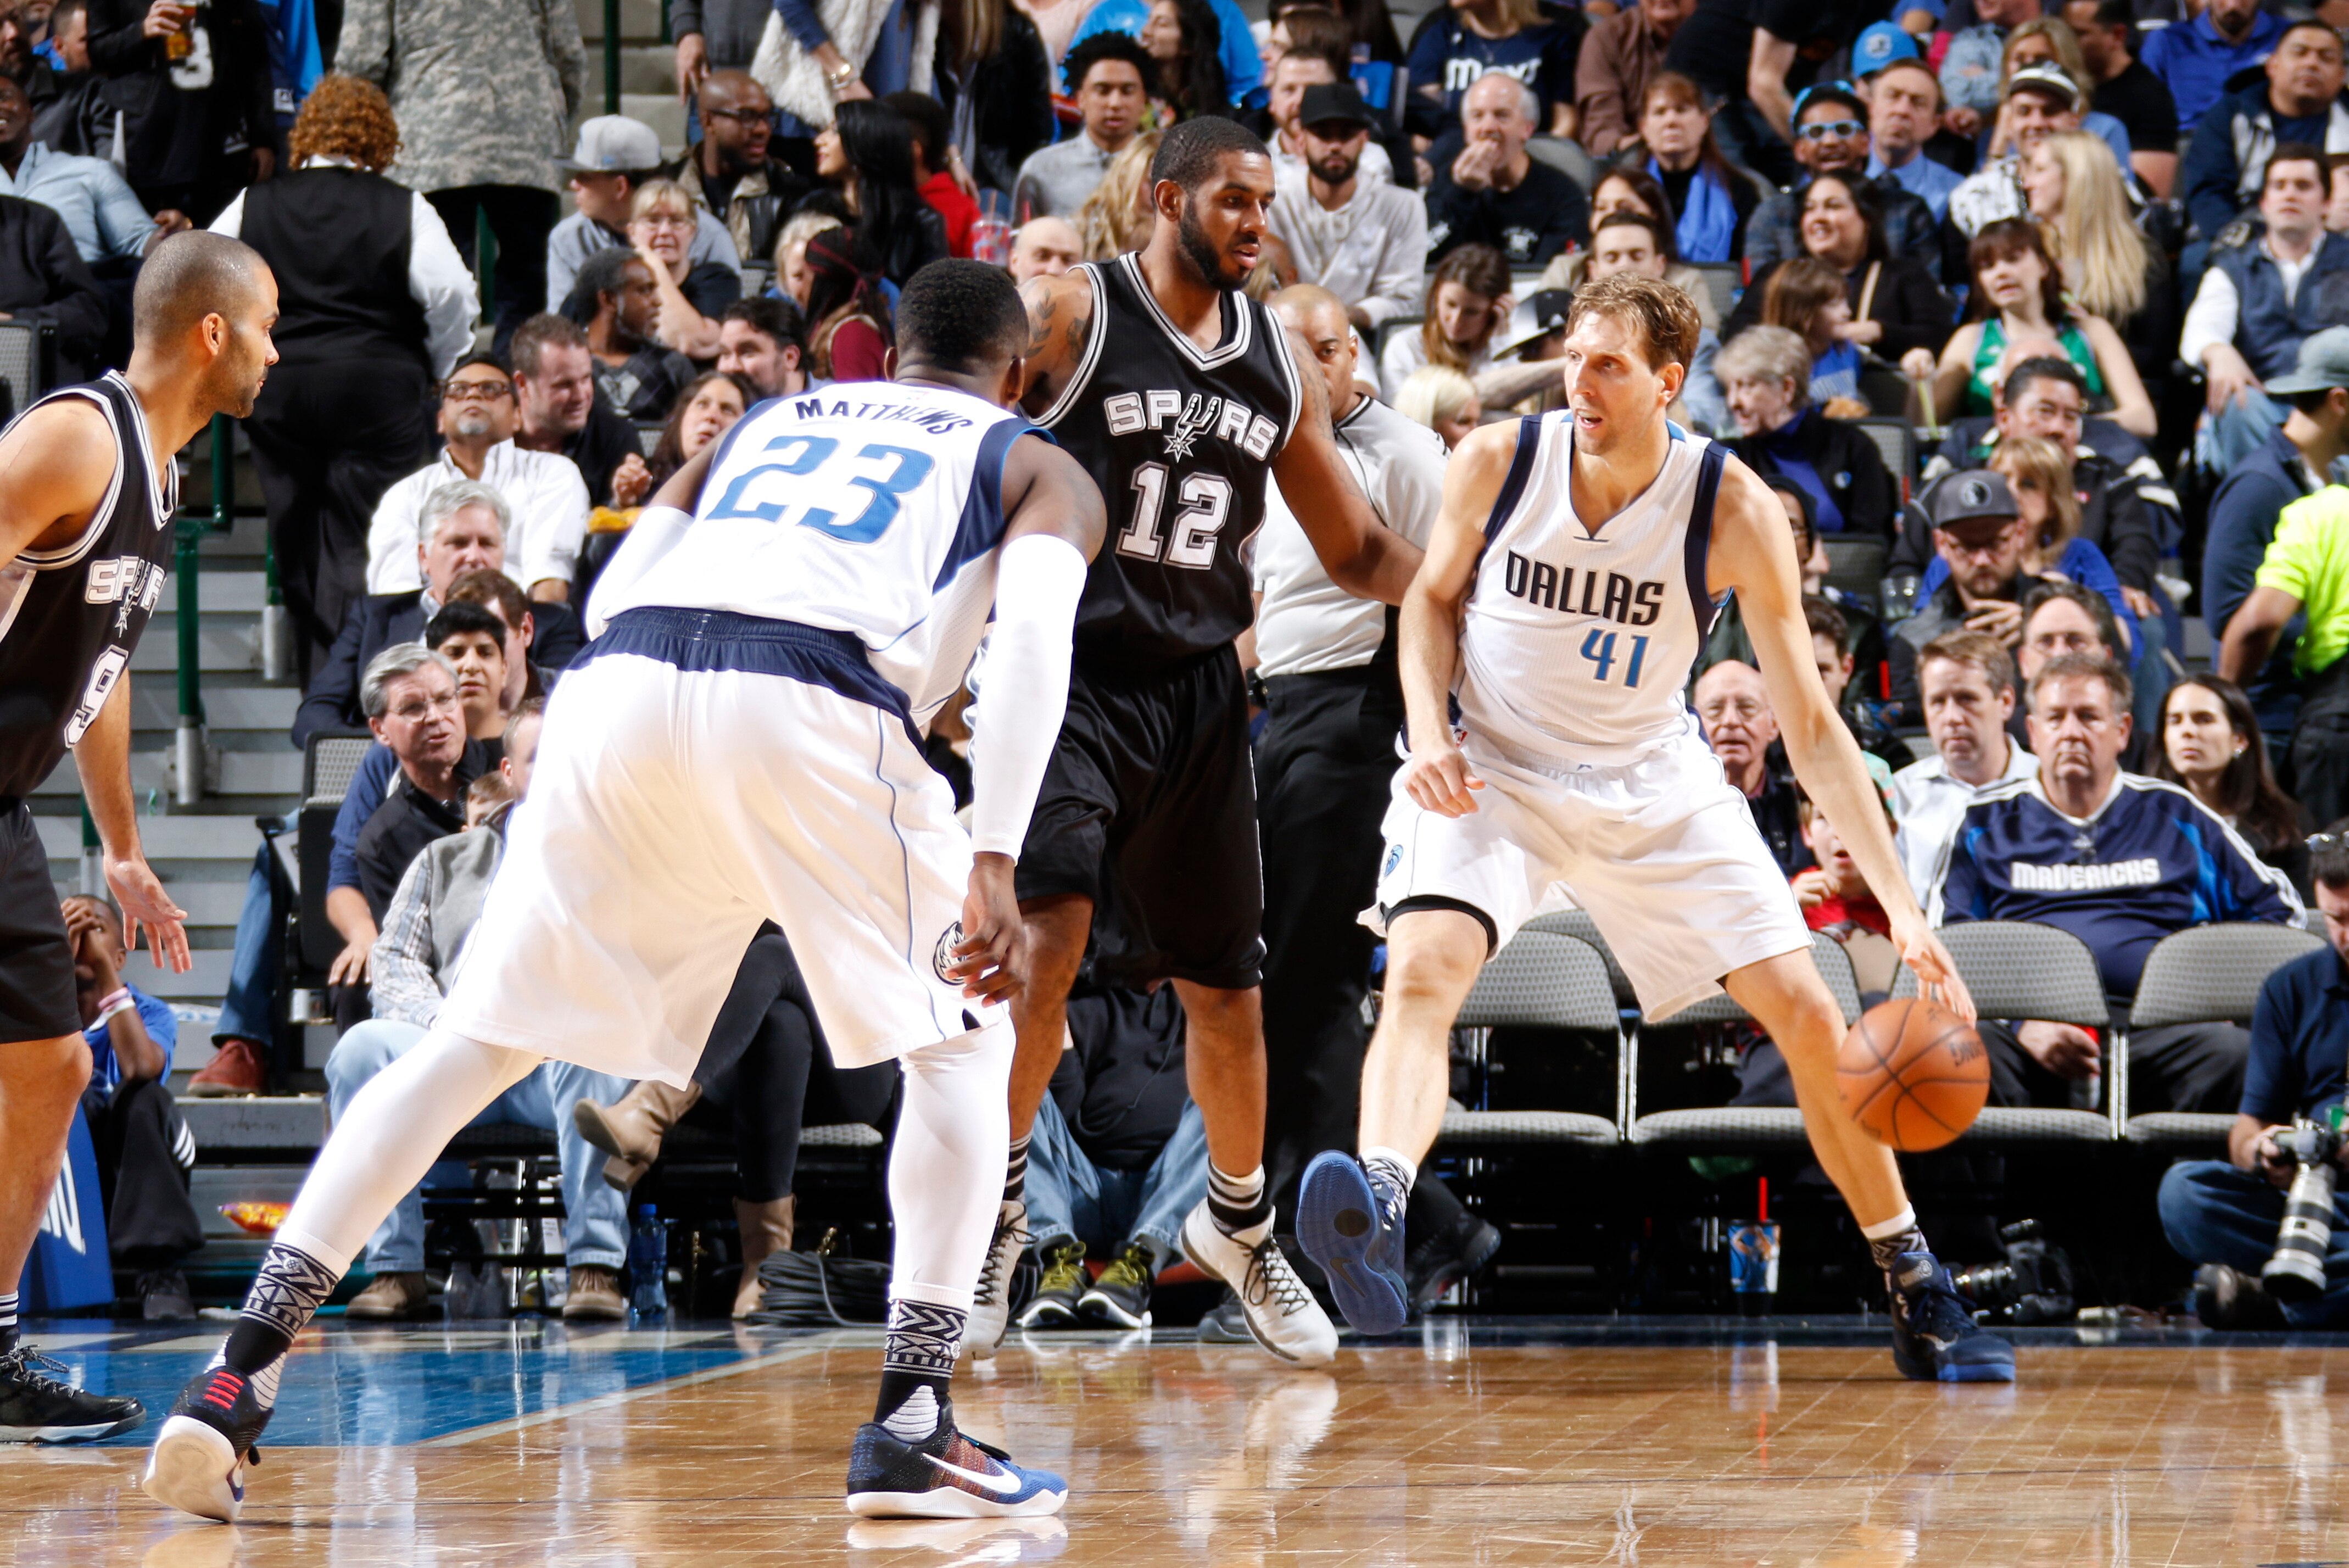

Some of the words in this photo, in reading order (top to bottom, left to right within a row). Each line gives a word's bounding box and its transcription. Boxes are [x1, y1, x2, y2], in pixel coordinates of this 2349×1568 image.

[795, 398, 974, 434] MATTHEWS
[1104, 390, 1279, 462] SPURS
[704, 436, 935, 544] 23
[1115, 460, 1234, 570] 12
[1505, 549, 1665, 626] DALLAS
[1579, 628, 1650, 688] 41
[64, 644, 129, 749] 9
[2011, 857, 2161, 891] MAVERICKS
